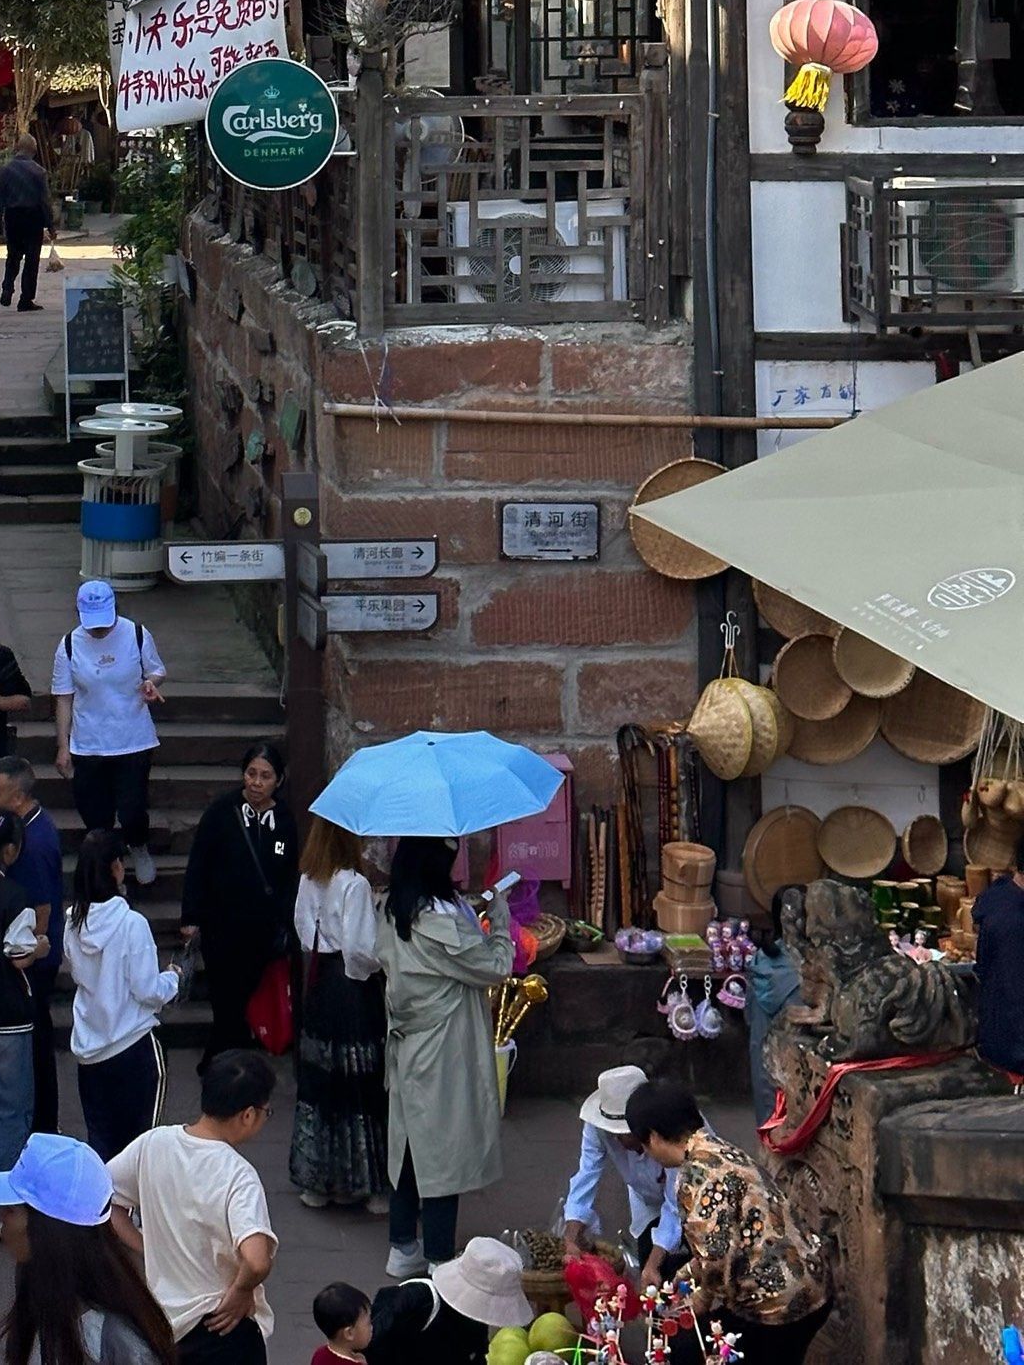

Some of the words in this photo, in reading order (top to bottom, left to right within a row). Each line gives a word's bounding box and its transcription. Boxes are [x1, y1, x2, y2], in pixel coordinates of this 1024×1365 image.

[222, 104, 323, 137] Carlsberg
[244, 146, 305, 157] DENMARK
[524, 510, 589, 528] 清河街
[201, 549, 264, 564] 竹编一条街
[353, 546, 404, 560] 清河长廊
[355, 598, 406, 612] 平乐果园
